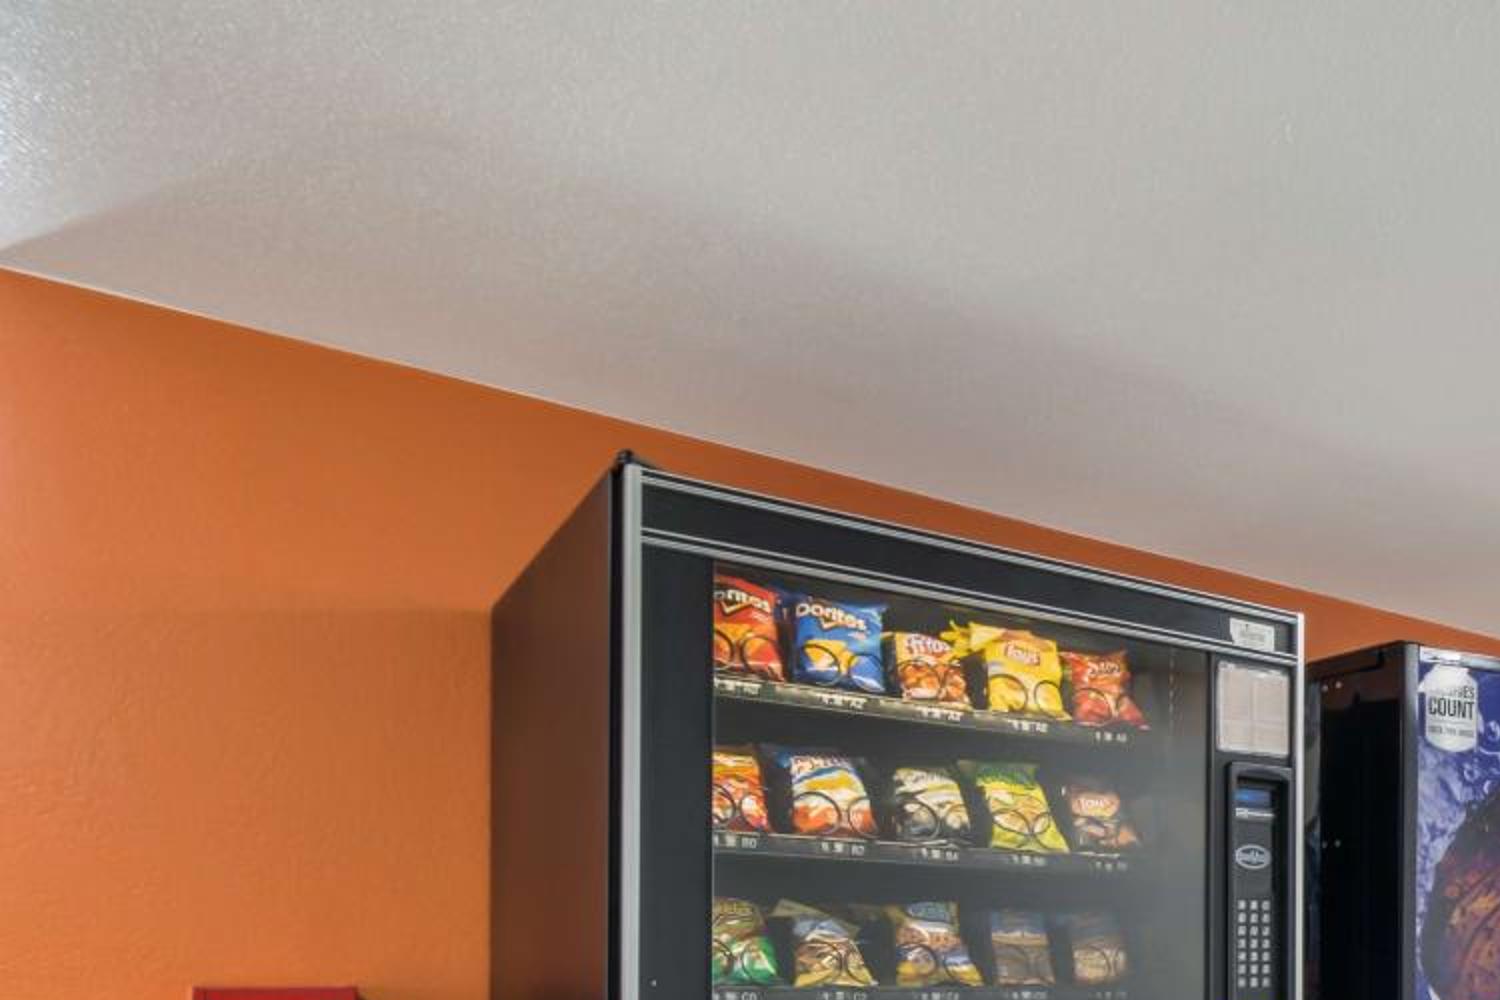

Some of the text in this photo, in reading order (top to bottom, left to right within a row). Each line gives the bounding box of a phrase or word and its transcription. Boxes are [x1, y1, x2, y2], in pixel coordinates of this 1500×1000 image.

[714, 588, 771, 614] oritos
[795, 602, 867, 631] Doritos
[1428, 697, 1475, 720] COUNT
